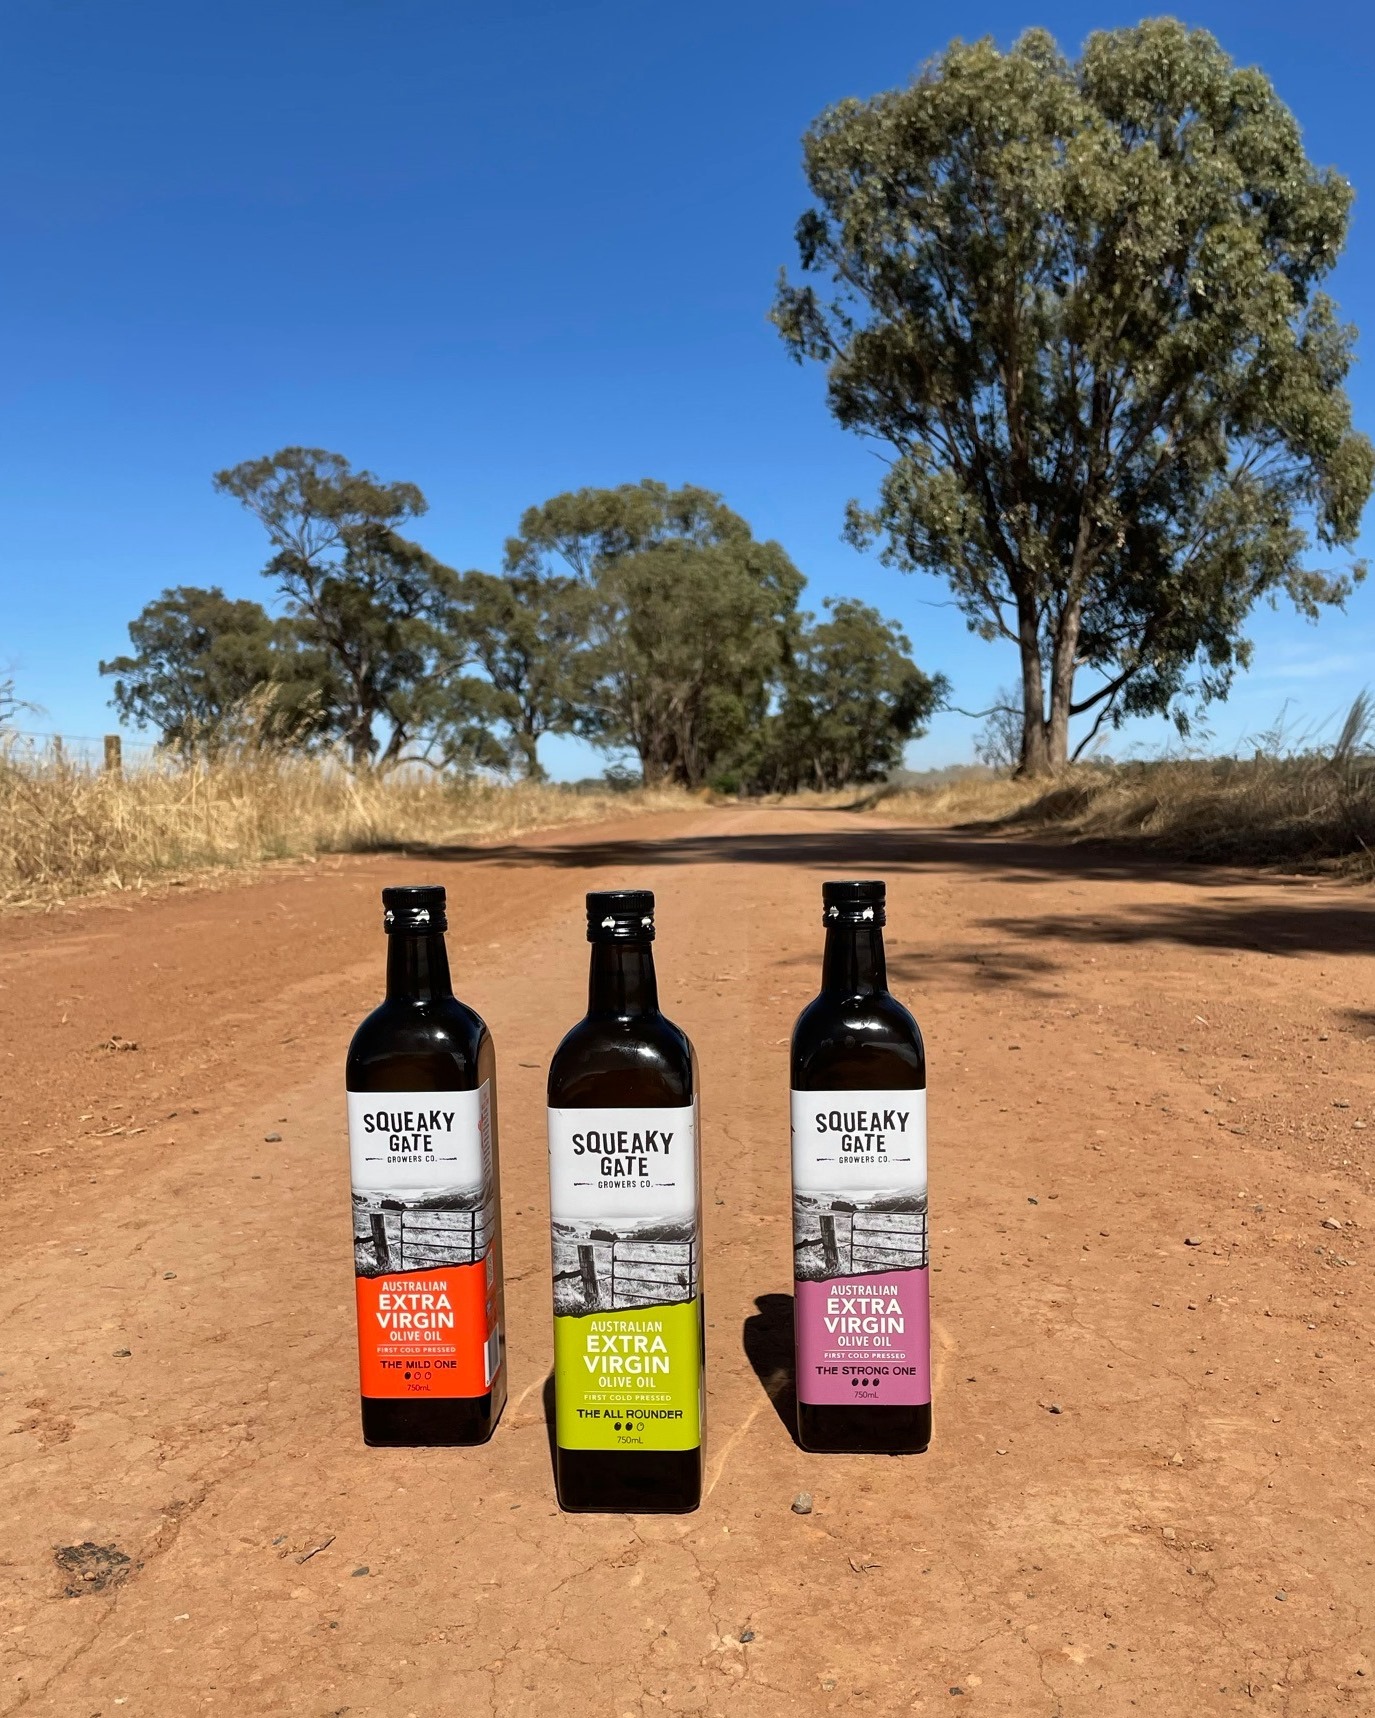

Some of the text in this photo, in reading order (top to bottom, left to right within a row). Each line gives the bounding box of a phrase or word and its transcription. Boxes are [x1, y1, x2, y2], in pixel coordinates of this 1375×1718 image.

[364, 1111, 455, 1133] SQUEAKY
[816, 1110, 909, 1133] SQUEAKY
[389, 1134, 433, 1152] GATE
[572, 1130, 673, 1155] SQUEAKY
[842, 1134, 886, 1153] GATE
[601, 1156, 649, 1177] GATE
[598, 1180, 653, 1188] GROWERS CO.
[382, 1281, 447, 1291] AUSTRALIAN
[831, 1285, 898, 1295] AUSTRALIAN
[379, 1294, 451, 1310] EXTRA
[827, 1298, 902, 1315] EXTRA
[376, 1312, 454, 1328] VIRGIN
[591, 1321, 662, 1332] AUSTRALIAN
[824, 1317, 904, 1334] VIRGIN
[390, 1331, 442, 1341] OLIVE OIL
[587, 1335, 667, 1353] EXTRA
[838, 1336, 891, 1346] OLIVE OIL
[434, 1360, 457, 1368] ONE
[583, 1355, 670, 1374] VIRGIN
[816, 1366, 916, 1375] THE STRONG ONE
[599, 1377, 656, 1388] OLIVE OIL
[577, 1409, 683, 1419] THE ALL ROUNDER
[617, 1436, 643, 1444] 750mL
